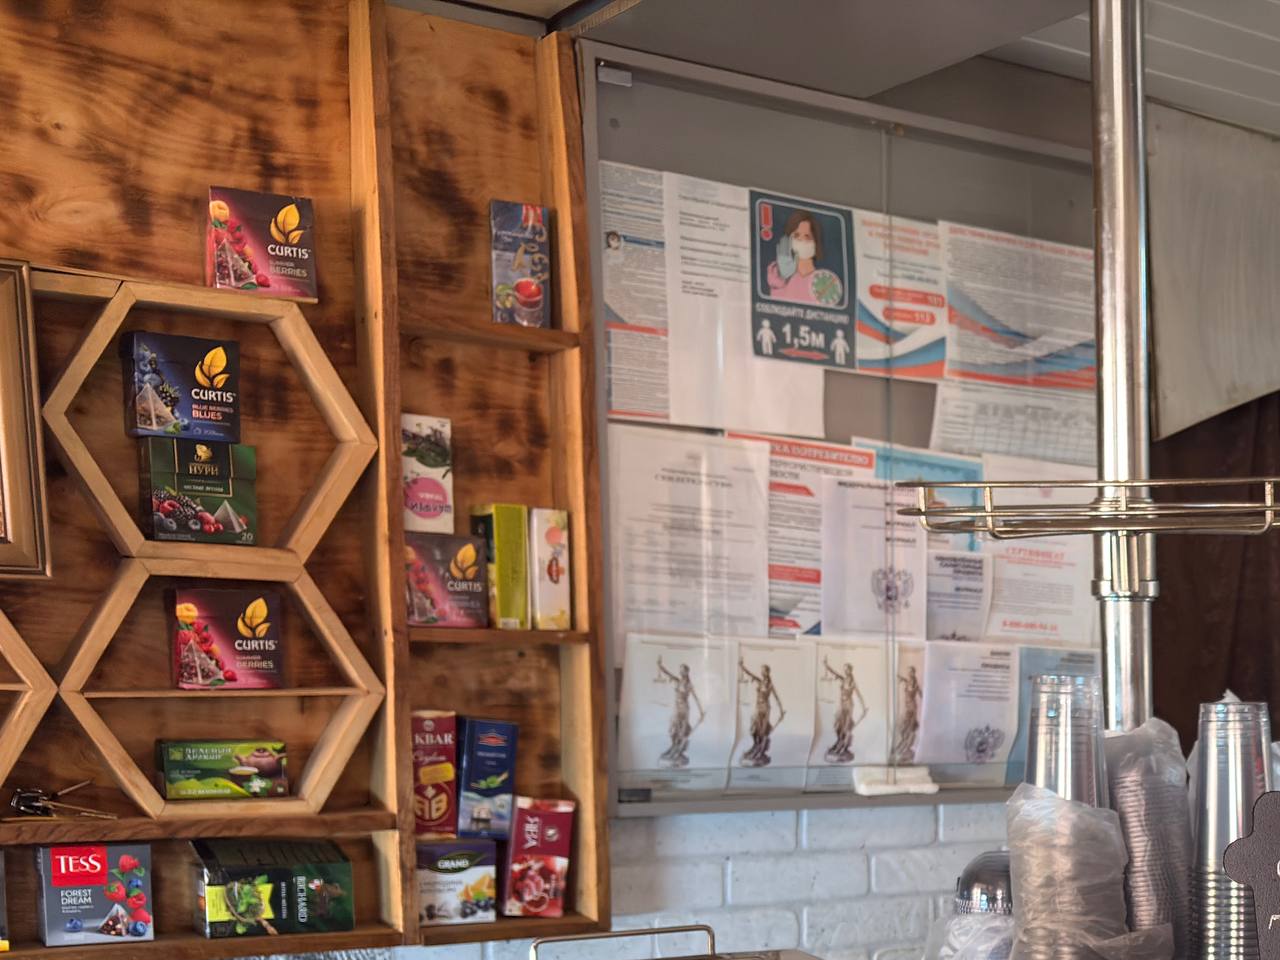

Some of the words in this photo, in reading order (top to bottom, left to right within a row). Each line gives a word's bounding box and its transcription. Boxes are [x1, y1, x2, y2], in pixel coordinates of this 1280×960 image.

[267, 244, 309, 259] CURTIS
[191, 388, 233, 403] CURTIS
[191, 409, 223, 420] BLUES
[447, 580, 482, 592] CURTIS
[234, 639, 276, 651] CURTIS
[414, 732, 454, 746] KBAR
[55, 853, 102, 874] TESS
[437, 859, 469, 870] GRAND
[60, 888, 92, 897] FOREST
[61, 896, 92, 905] DREAM
